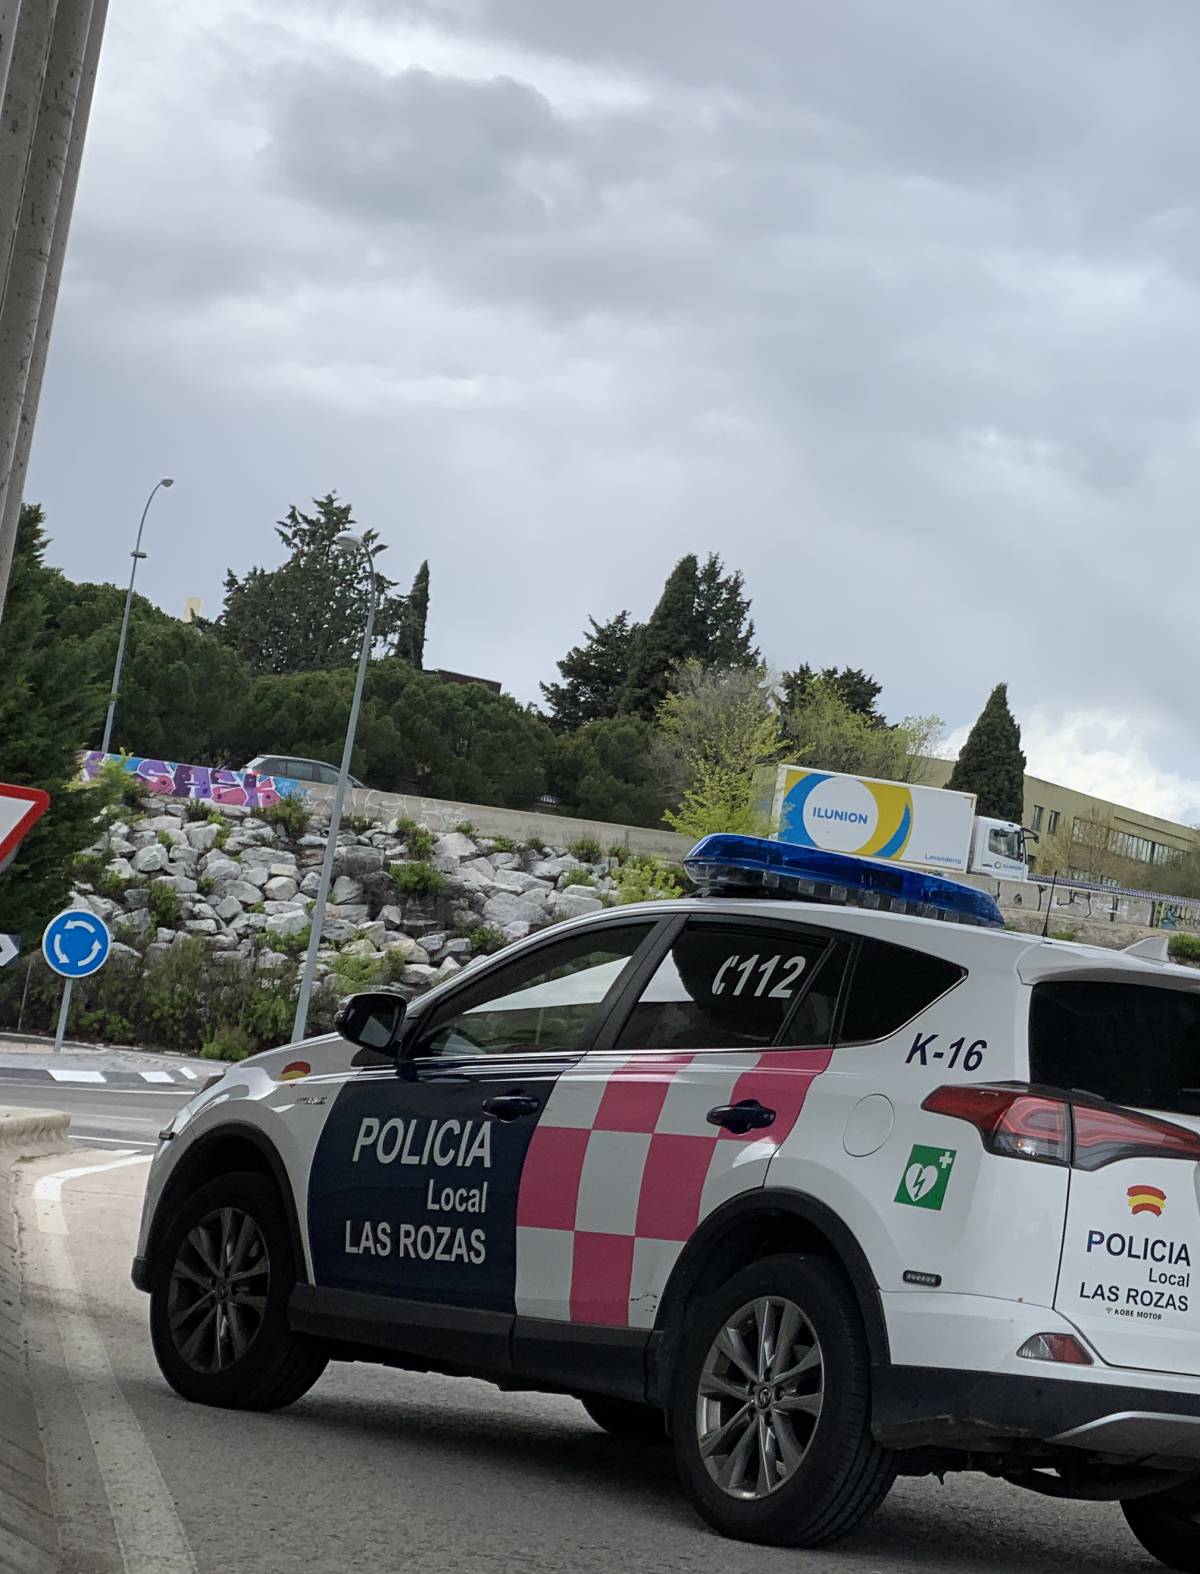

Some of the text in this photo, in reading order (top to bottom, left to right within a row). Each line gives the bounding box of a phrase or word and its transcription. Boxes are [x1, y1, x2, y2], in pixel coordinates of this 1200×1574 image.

[812, 806, 868, 825] ILUNION
[905, 1033, 988, 1071] K-16
[352, 1117, 492, 1168] POLICIA
[427, 1179, 488, 1213] Local
[345, 1220, 486, 1265] LAS ROZAS
[1086, 1230, 1191, 1267] POLICIA
[1148, 1267, 1190, 1288] Local
[1079, 1281, 1189, 1312] LAS ROZAS
